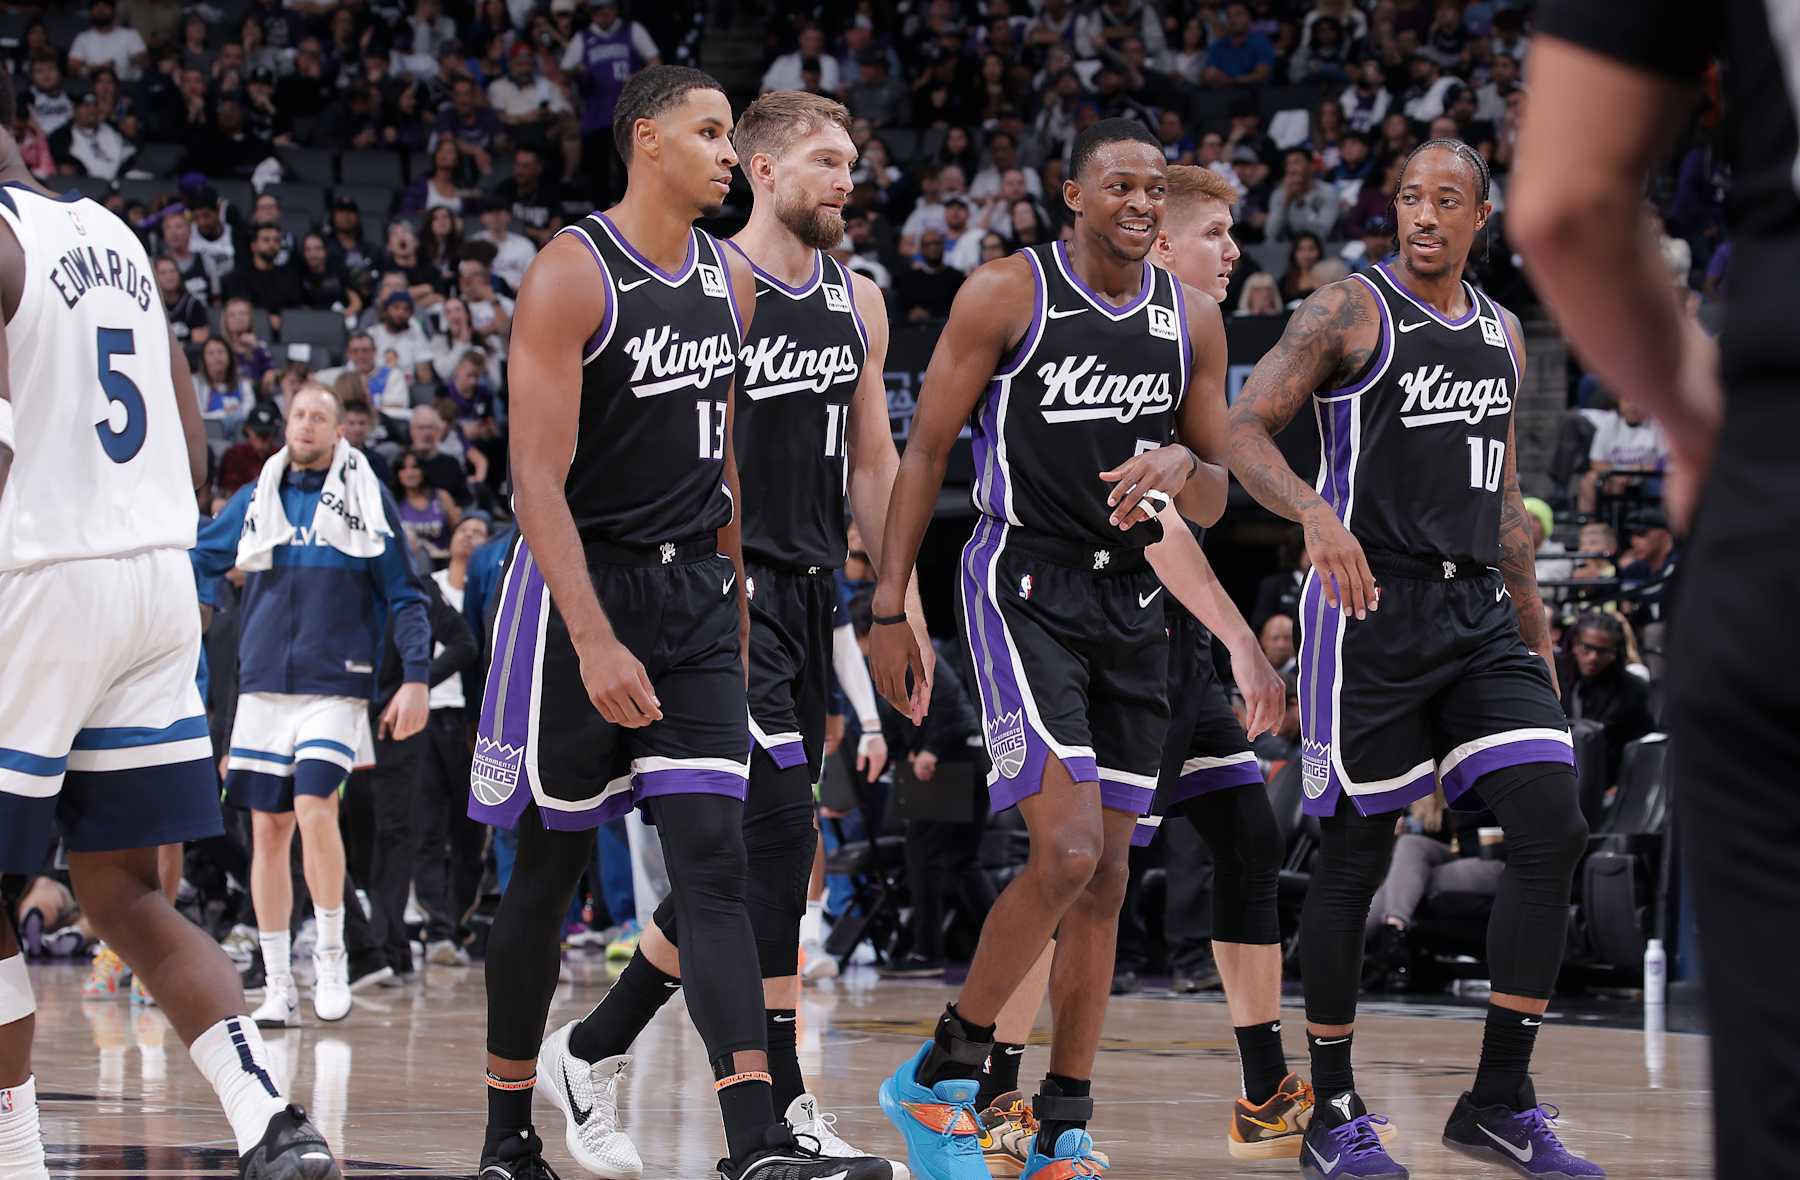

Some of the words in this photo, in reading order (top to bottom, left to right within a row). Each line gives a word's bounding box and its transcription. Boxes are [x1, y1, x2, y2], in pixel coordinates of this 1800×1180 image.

[50, 246, 152, 312] EDWARDS
[703, 268, 719, 286] R
[827, 286, 843, 302] R
[1154, 309, 1170, 328] R
[1485, 320, 1499, 337] R
[624, 325, 736, 398] Kings
[738, 335, 858, 401] Kings
[1037, 355, 1172, 424] Kings
[95, 326, 148, 464] 5
[1398, 364, 1511, 428] Kings
[696, 400, 727, 460] 13
[1467, 436, 1506, 493] 10
[471, 760, 517, 786] KINGS
[992, 735, 1025, 759] KINGS
